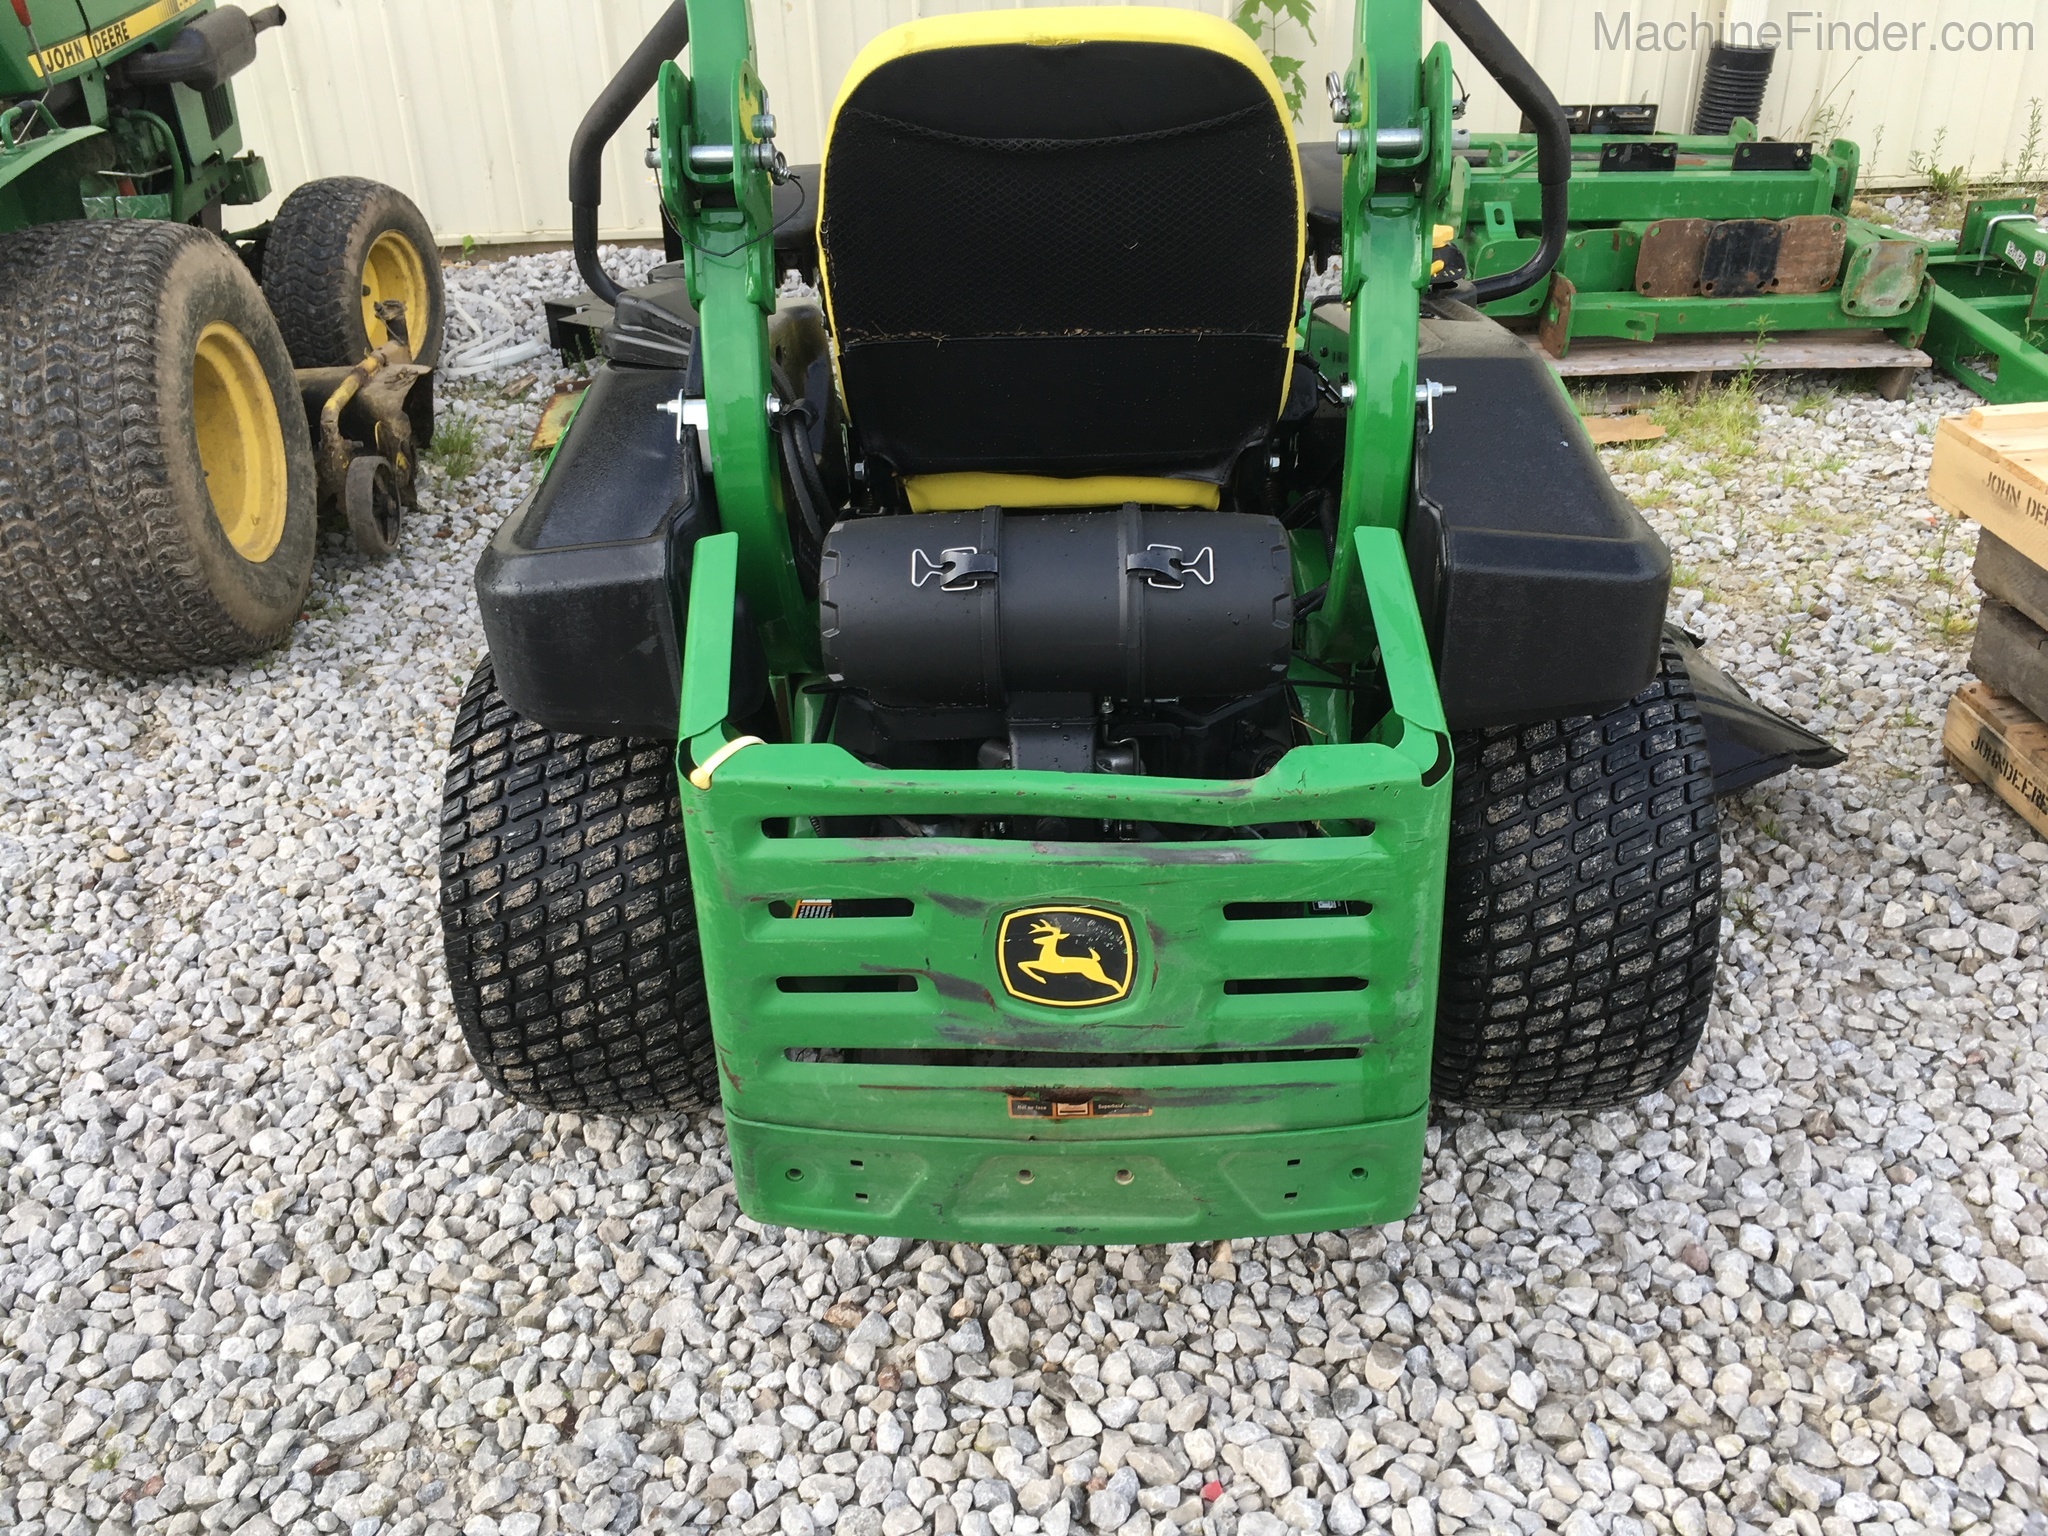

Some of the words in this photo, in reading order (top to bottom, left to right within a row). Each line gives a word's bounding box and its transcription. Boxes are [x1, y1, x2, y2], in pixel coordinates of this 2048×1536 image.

[45, 39, 86, 73] JOHN
[92, 20, 130, 55] DEERE
[1986, 471, 2022, 508] JOHN
